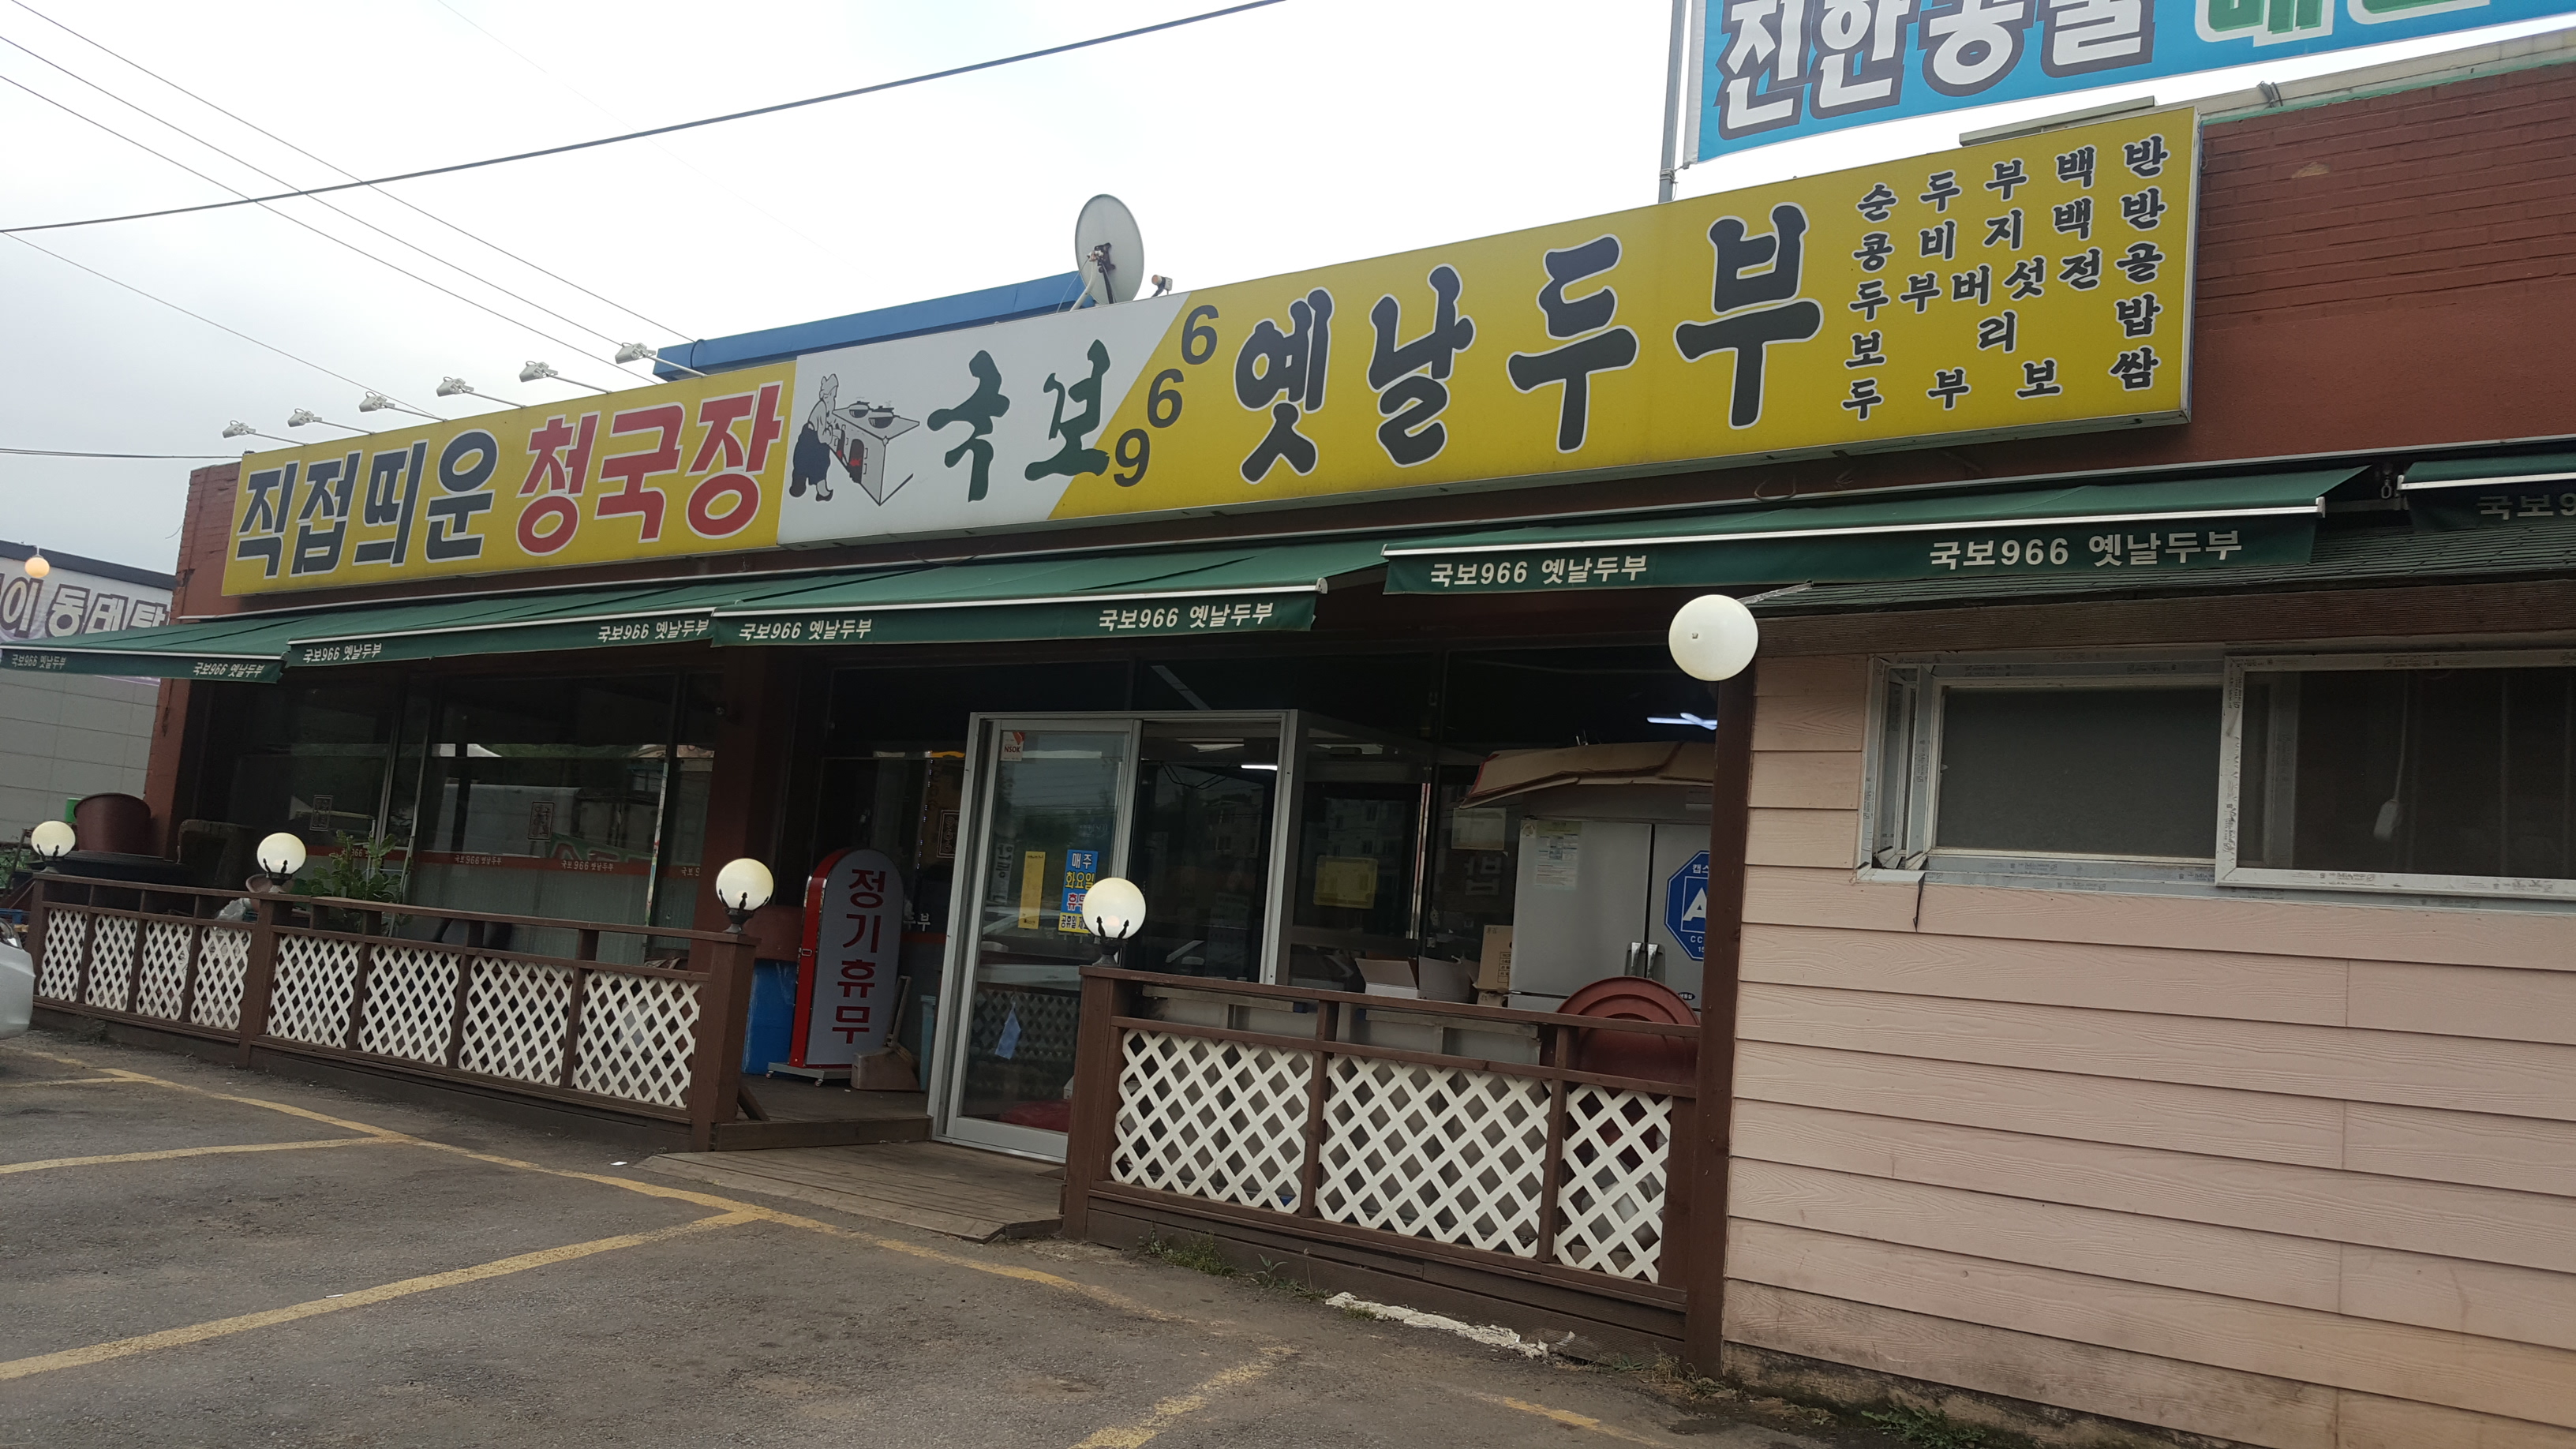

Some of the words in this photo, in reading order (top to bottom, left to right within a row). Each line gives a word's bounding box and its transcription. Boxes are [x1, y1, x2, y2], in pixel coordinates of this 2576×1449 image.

[1856, 134, 2170, 222] 순두부백반
[1852, 186, 2166, 273] 콩비지백반
[1848, 242, 2165, 321] 두부버섯전골
[1233, 201, 1824, 485] 옛날두부
[1841, 346, 2160, 421] 두부보쌈
[927, 339, 1110, 503] 국보
[515, 380, 784, 557] 청국장
[1928, 535, 2070, 571] 국보966
[2087, 529, 2243, 568] 옛날두부
[1429, 560, 1529, 588] 국보966
[1541, 555, 1648, 585] 옛날두부
[597, 624, 650, 643] 국보966
[656, 619, 710, 640] 옛날두부
[739, 622, 801, 642] 국보966
[807, 618, 873, 641] 옛날두부
[1098, 606, 1180, 631] 국보966
[1188, 601, 1274, 629] 옛날두부
[302, 646, 341, 664] 국보966
[343, 642, 383, 661] 옛날두부
[1065, 871, 1095, 891] 화요일
[1071, 852, 1093, 870] 매주
[1061, 914, 1077, 929] 공휴일
[831, 868, 887, 1044] 정기휴무
